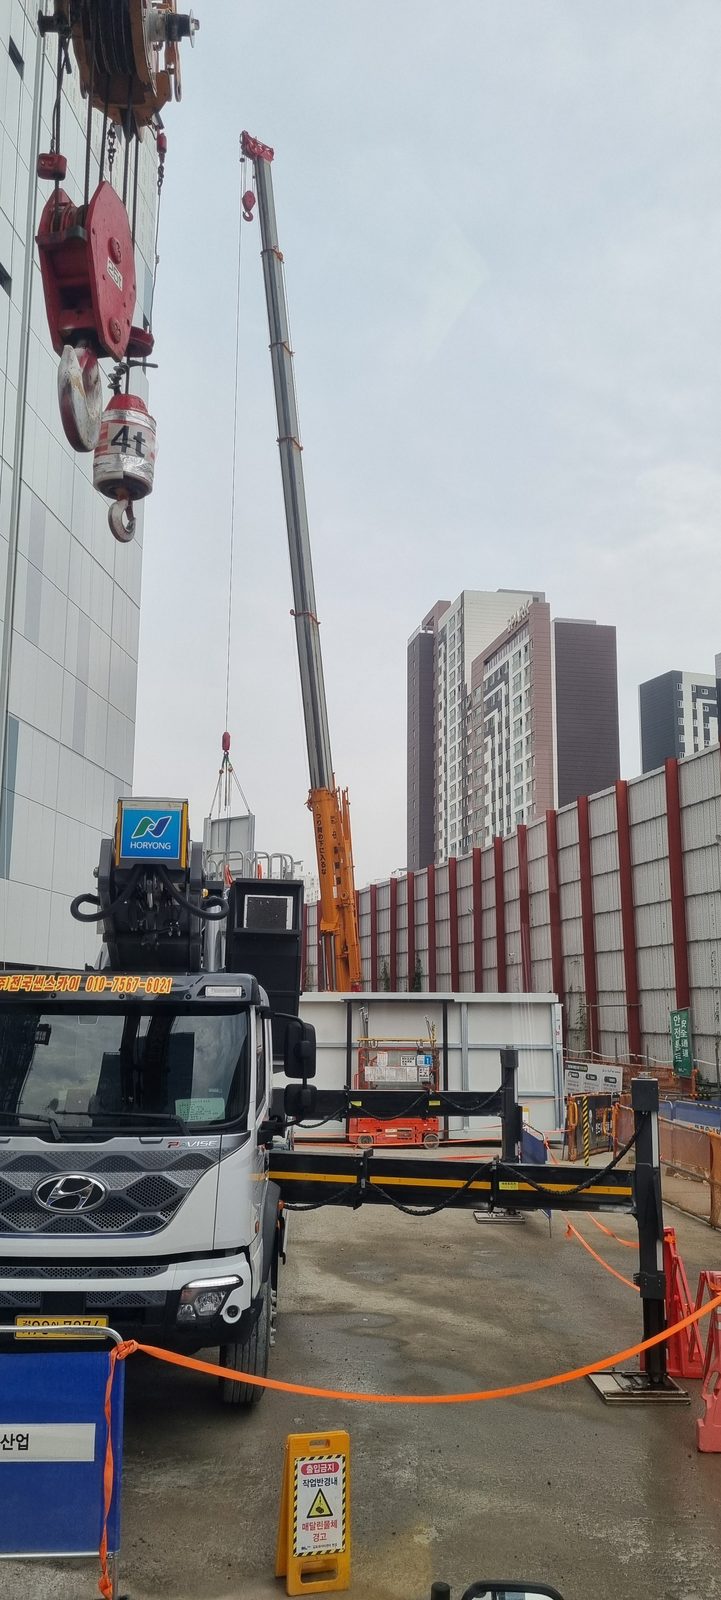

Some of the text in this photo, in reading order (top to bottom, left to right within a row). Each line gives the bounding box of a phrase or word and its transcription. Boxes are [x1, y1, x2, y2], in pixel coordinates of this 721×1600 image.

[111, 425, 146, 458] 4t
[130, 841, 172, 850] HORYONG
[85, 976, 173, 994] 010-7567-6021
[306, 1463, 335, 1474] 출입금지
[302, 1477, 338, 1488] 작업반경내
[302, 1520, 338, 1531] 매달린물체
[312, 1533, 327, 1543] 경고
